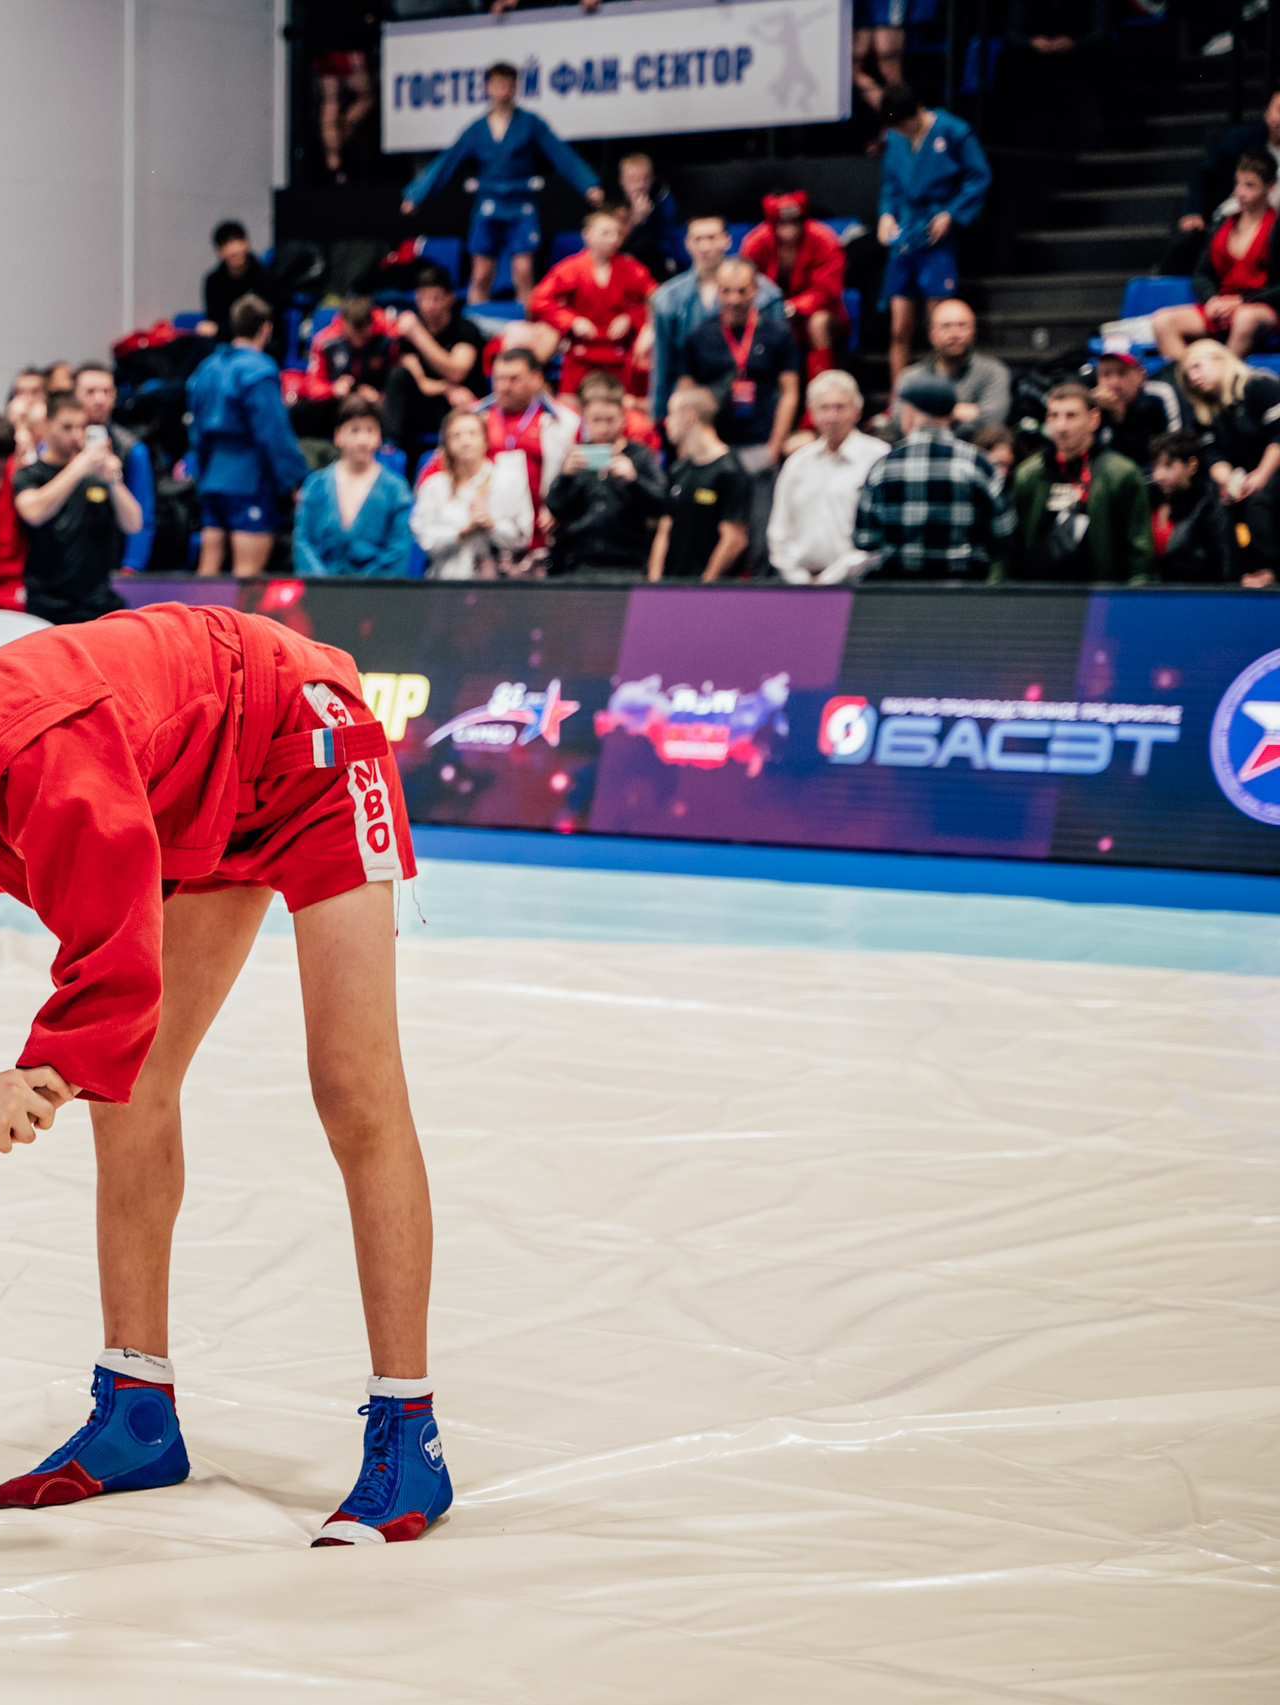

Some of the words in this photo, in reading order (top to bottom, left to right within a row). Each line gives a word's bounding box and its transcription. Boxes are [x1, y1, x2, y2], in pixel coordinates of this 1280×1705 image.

[395, 55, 540, 110] ГОСТЕЙ
[550, 45, 753, 98] ФАН-СЕКТОР
[874, 713, 1180, 776] БАСЭТ
